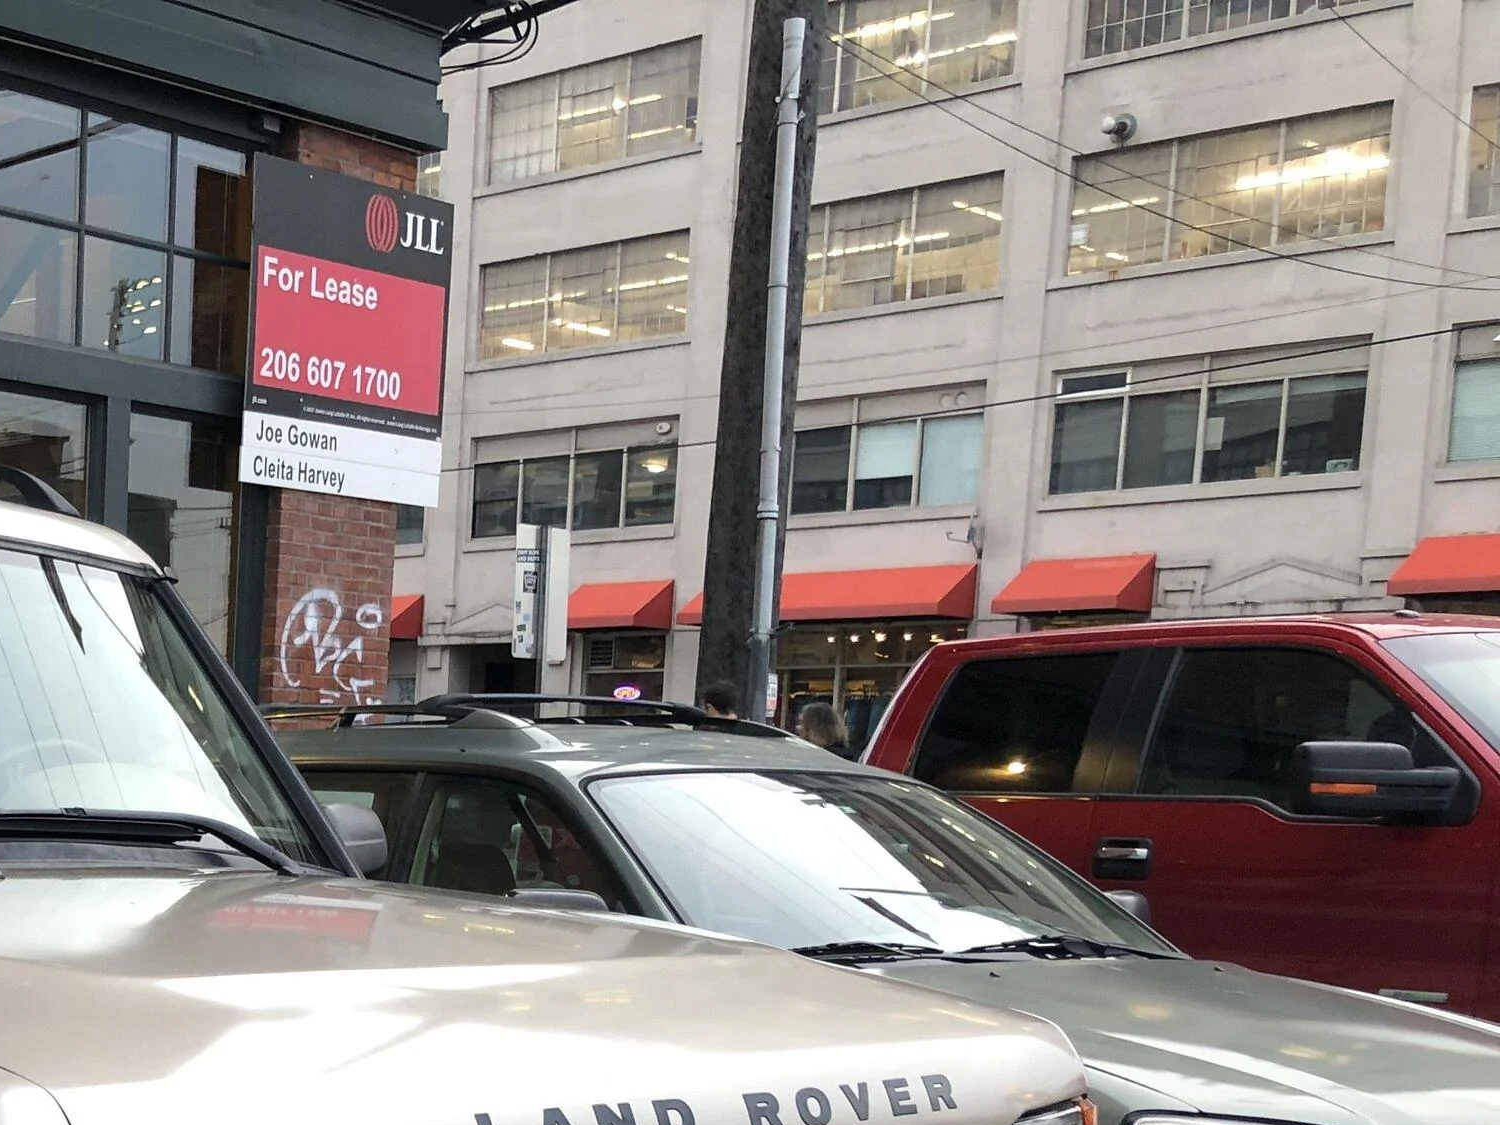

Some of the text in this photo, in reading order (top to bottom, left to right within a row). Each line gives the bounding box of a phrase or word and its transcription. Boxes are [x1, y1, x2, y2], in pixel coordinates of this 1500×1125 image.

[400, 212, 444, 255] JLL
[263, 255, 378, 310] For Lease
[260, 347, 401, 401] 206 607 1700
[256, 420, 338, 452] Joe Gowan
[253, 455, 345, 493] Cleita Harvey
